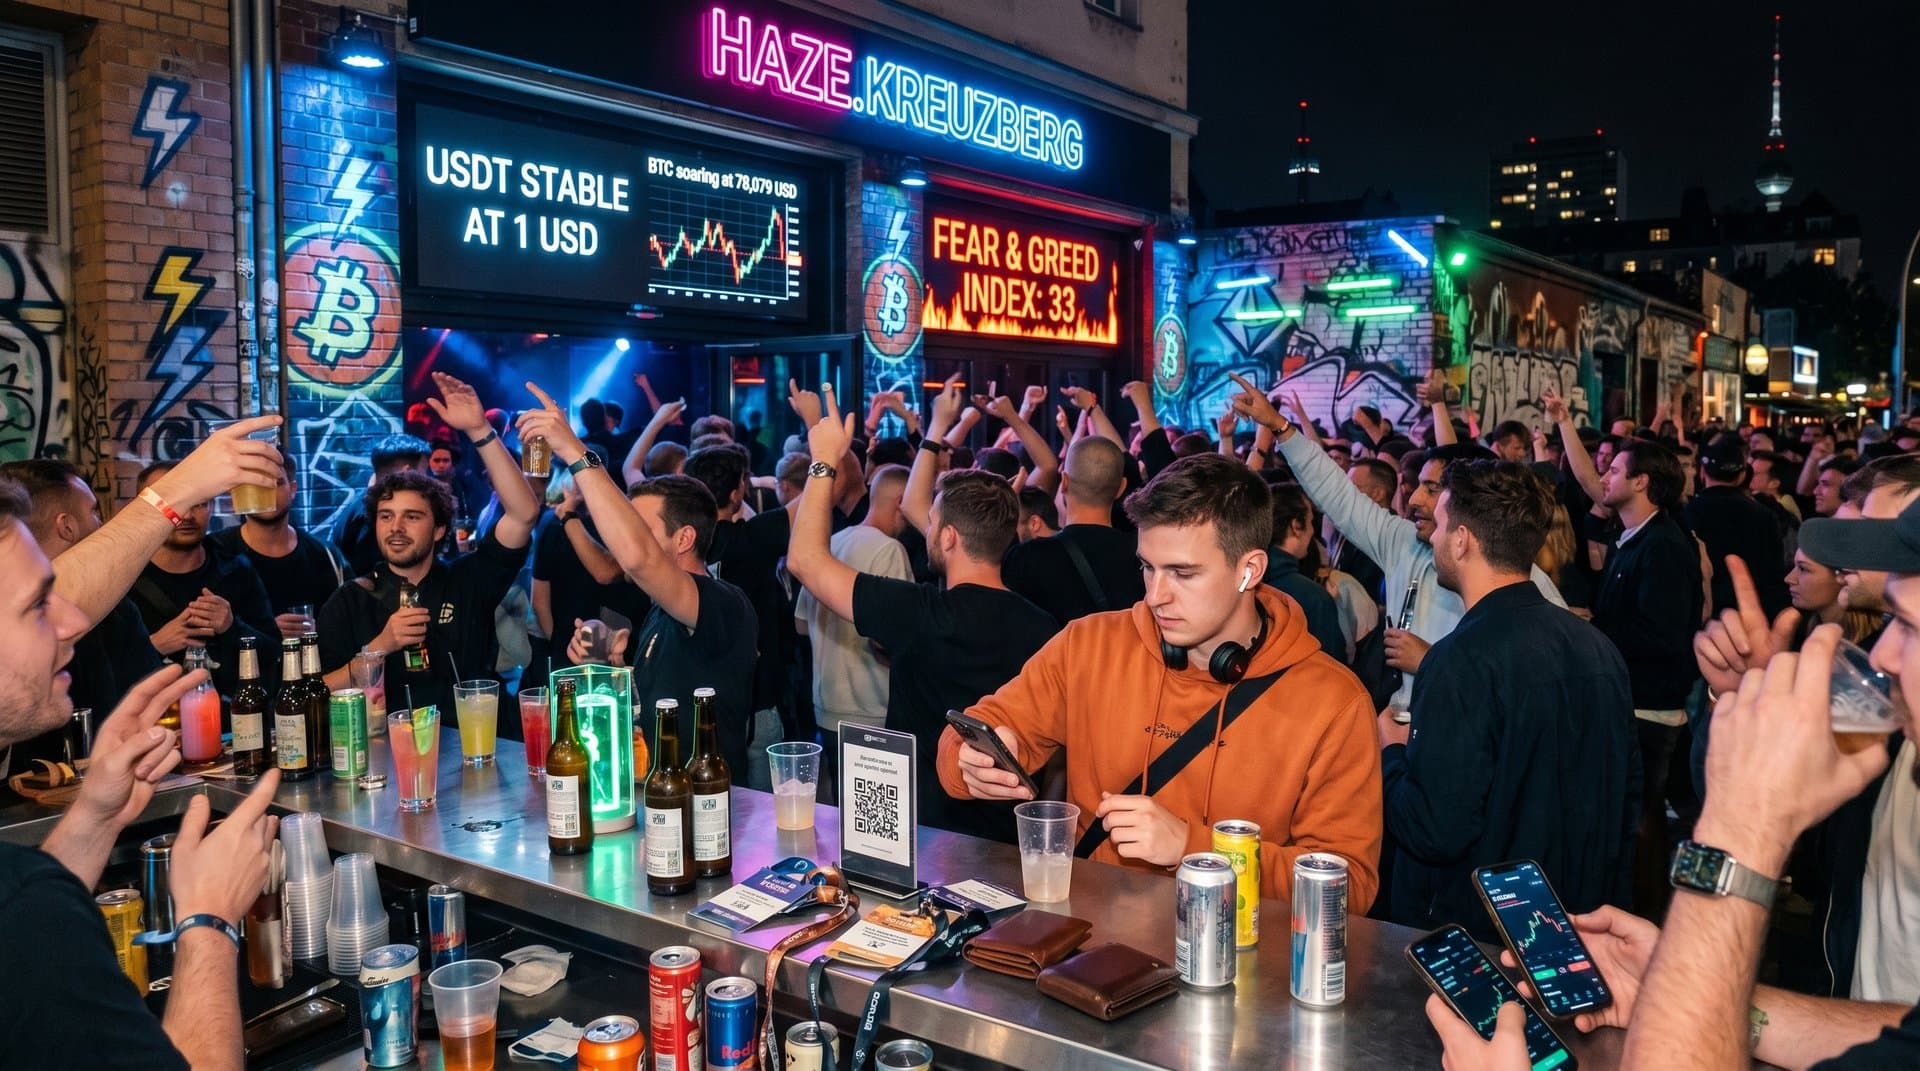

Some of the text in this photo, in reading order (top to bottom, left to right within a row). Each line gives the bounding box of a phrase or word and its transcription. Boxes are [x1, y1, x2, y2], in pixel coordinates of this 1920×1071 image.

[711, 7, 1084, 171] HAZE.KREUZBERG
[426, 145, 630, 213] USDT STABLE
[647, 156, 798, 199] BTC soaring at 78,079 USD
[463, 207, 599, 256] AT 1 USD
[933, 217, 1100, 282] FEAR & GREED
[963, 271, 1076, 323] INDEX: 33
